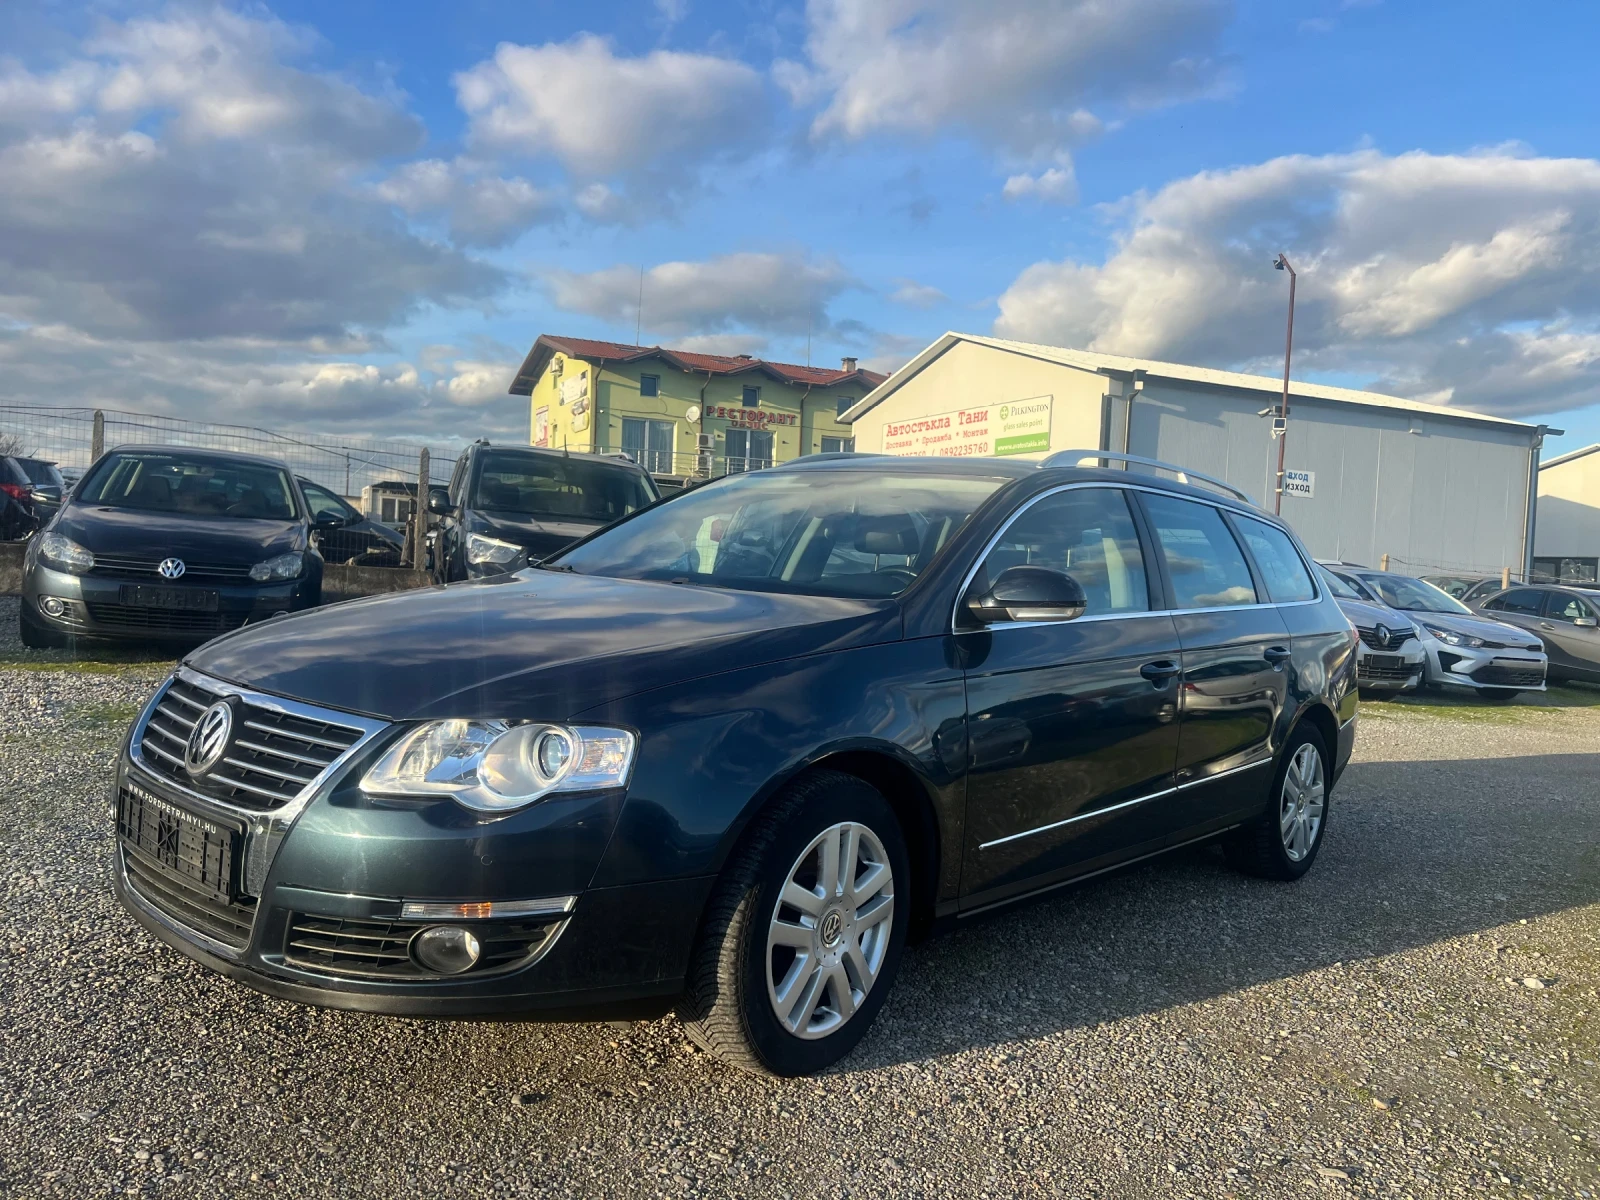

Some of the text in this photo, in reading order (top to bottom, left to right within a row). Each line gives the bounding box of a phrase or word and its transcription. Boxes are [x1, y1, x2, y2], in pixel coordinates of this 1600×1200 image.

[706, 405, 797, 425] РЕСТОРАНТ
[1010, 403, 1049, 416] PILKINGTON
[886, 410, 989, 437] Автостъкла Тани
[1003, 418, 1043, 432] glass sales point
[940, 442, 988, 457] 0892235760
[1287, 471, 1309, 482] ВХОД
[1284, 482, 1310, 493] ИЗХОД
[128, 782, 217, 834] WWW.FORDPETRANYI.HU
